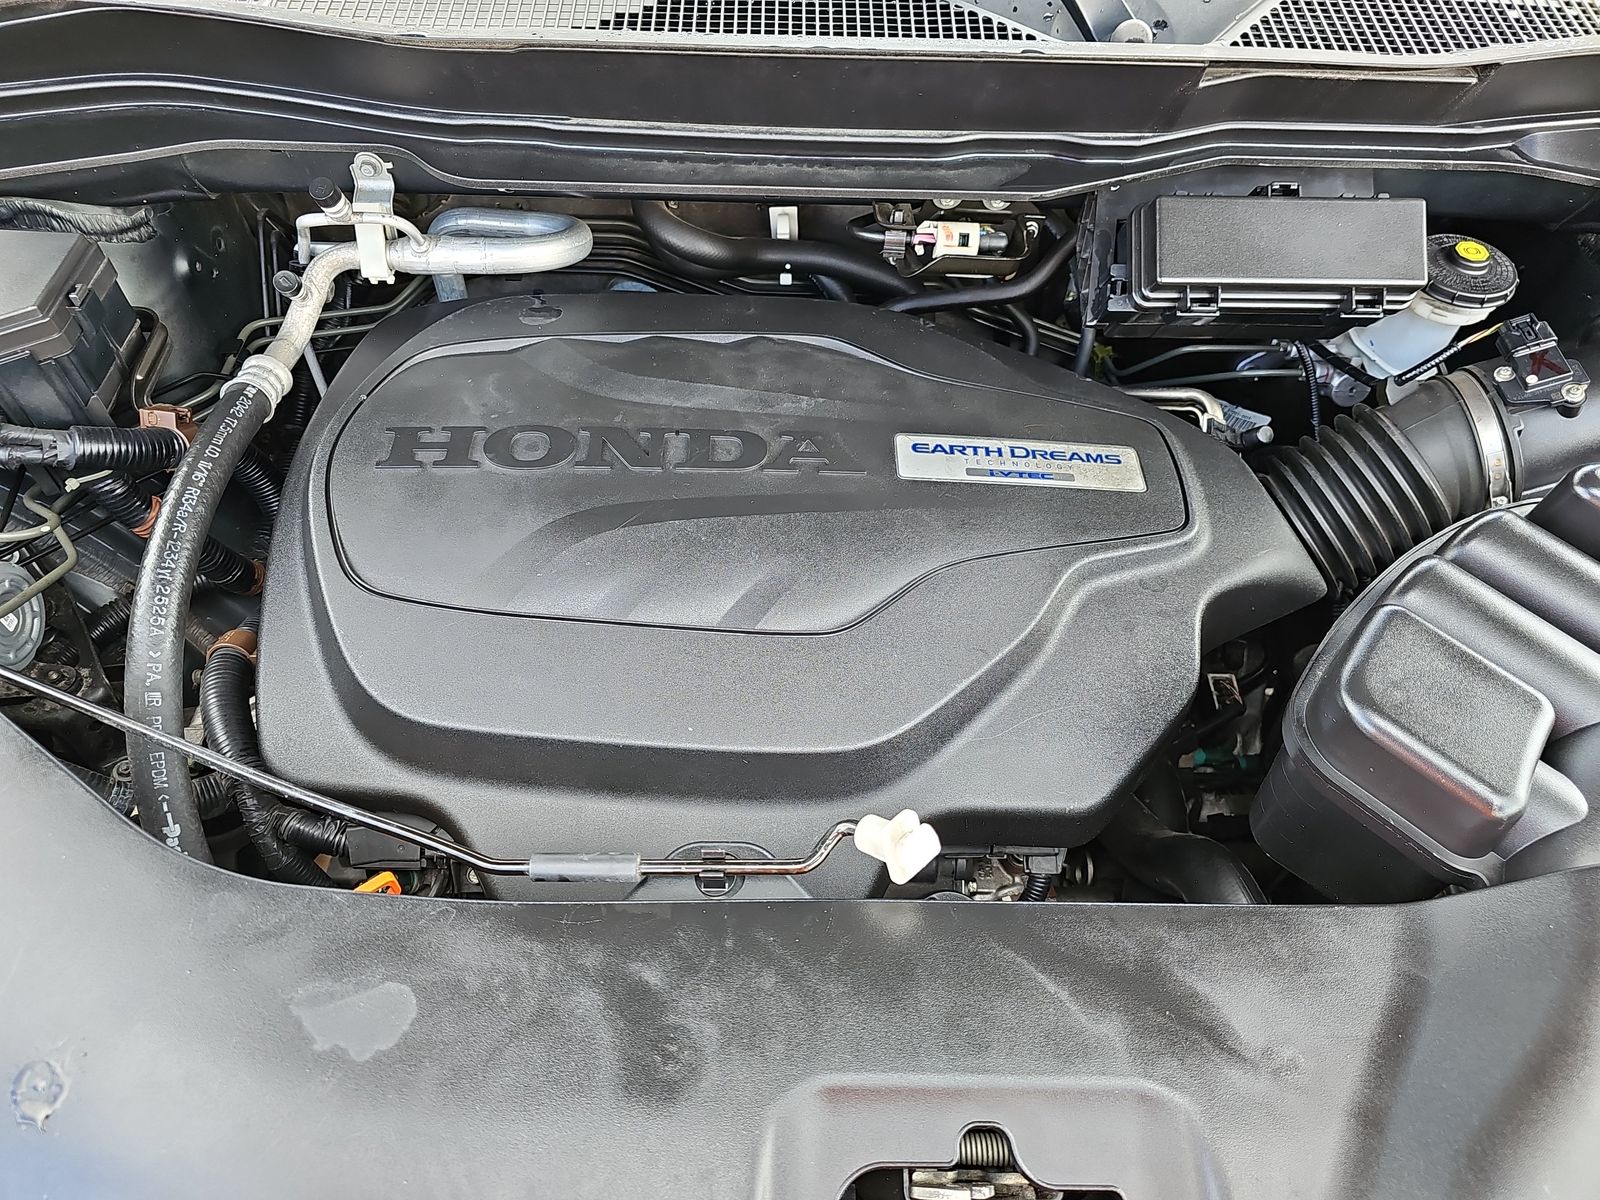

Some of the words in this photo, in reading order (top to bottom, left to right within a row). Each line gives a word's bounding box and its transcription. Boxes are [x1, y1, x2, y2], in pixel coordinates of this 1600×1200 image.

[230, 395, 252, 418] 2042
[375, 425, 868, 475] HONDA
[911, 442, 1005, 458] EARTH
[964, 459, 1074, 470] TECHNOLOGY
[987, 468, 1055, 480] i-VTEC
[149, 584, 171, 637] 2525A
[150, 751, 169, 790] EPDM
